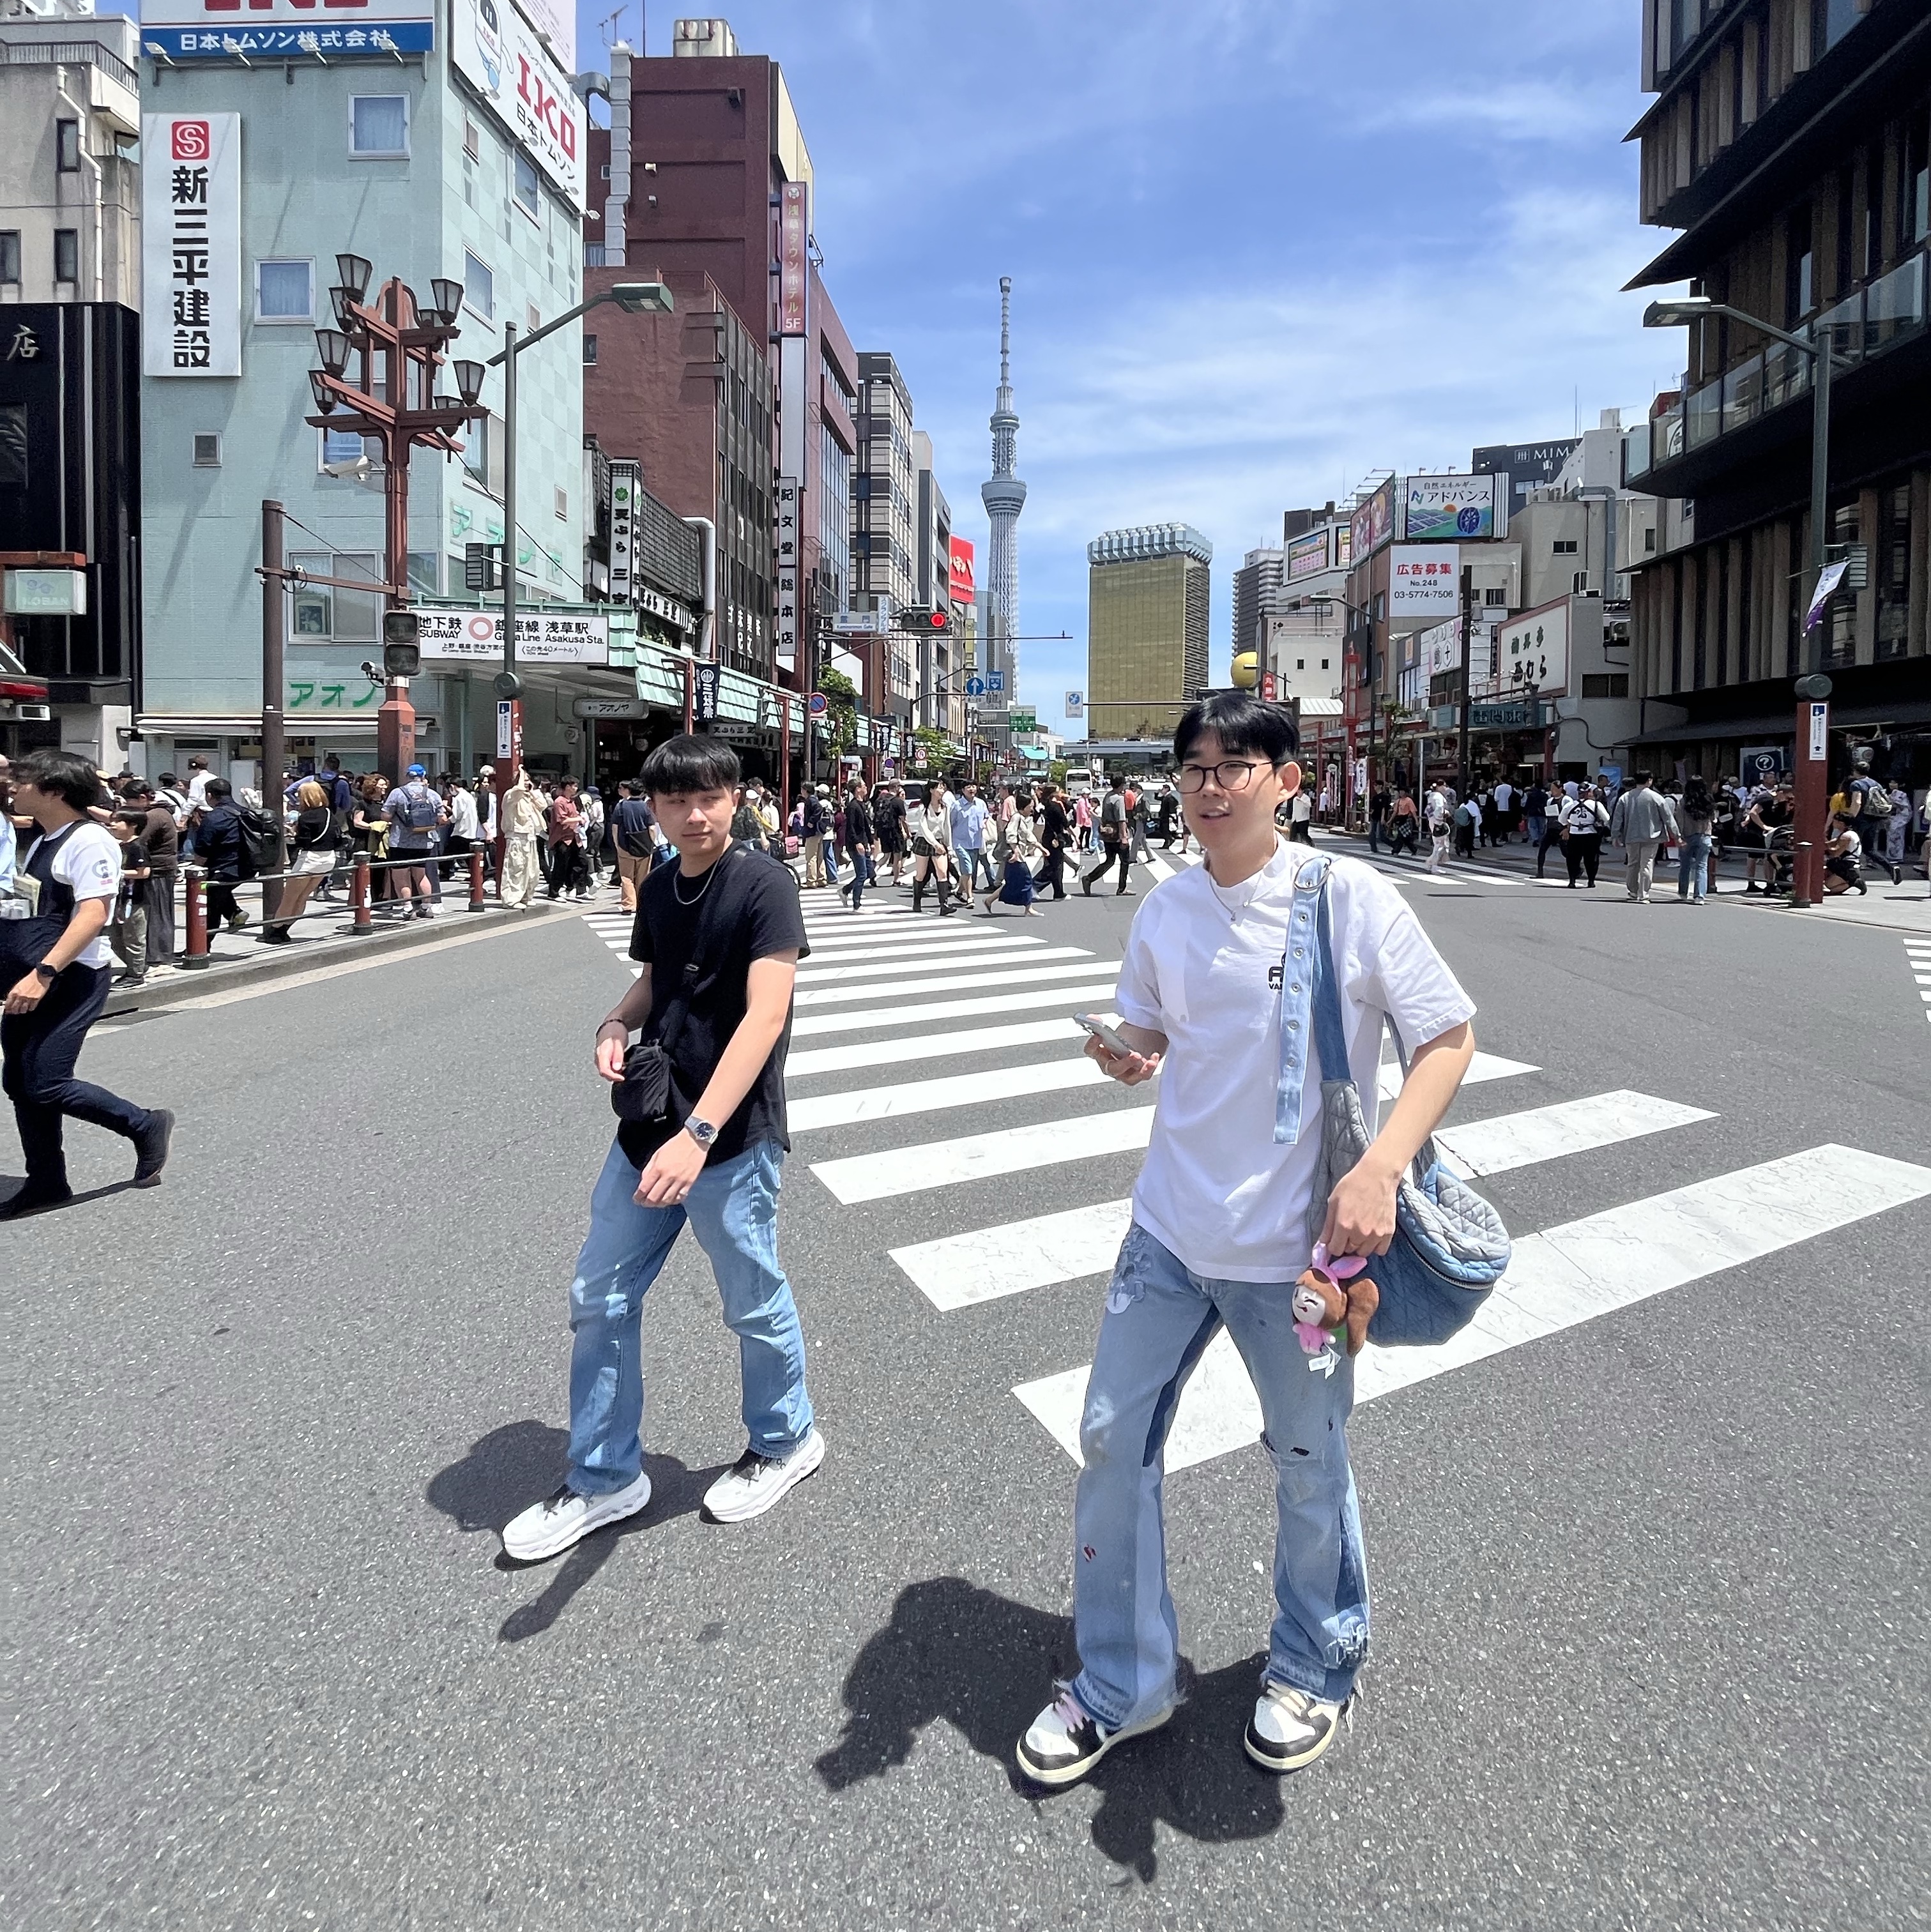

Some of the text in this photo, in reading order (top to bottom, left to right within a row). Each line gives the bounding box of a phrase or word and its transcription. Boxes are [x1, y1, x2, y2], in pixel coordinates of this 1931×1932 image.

[181, 29, 392, 50] 日本トムソン株式会社
[517, 52, 575, 163] IKO
[517, 102, 575, 179] 日本トムソン
[171, 165, 210, 368] 新三平建設
[785, 317, 800, 329] 5F
[6, 323, 40, 361] 店
[1424, 482, 1477, 490] 自然エネルギー
[1428, 490, 1490, 503] アドバンス
[1396, 563, 1452, 575] 広告募集
[1394, 590, 1454, 598] 03-5774-7506
[419, 616, 462, 630] 地下鉄
[545, 620, 589, 635] 浅草駅
[419, 629, 461, 639] SUBWAY
[494, 632, 521, 642] Gia
[545, 634, 585, 644] Asakusa
[587, 635, 605, 645] Sta.
[599, 704, 629, 713] アオノヤ
